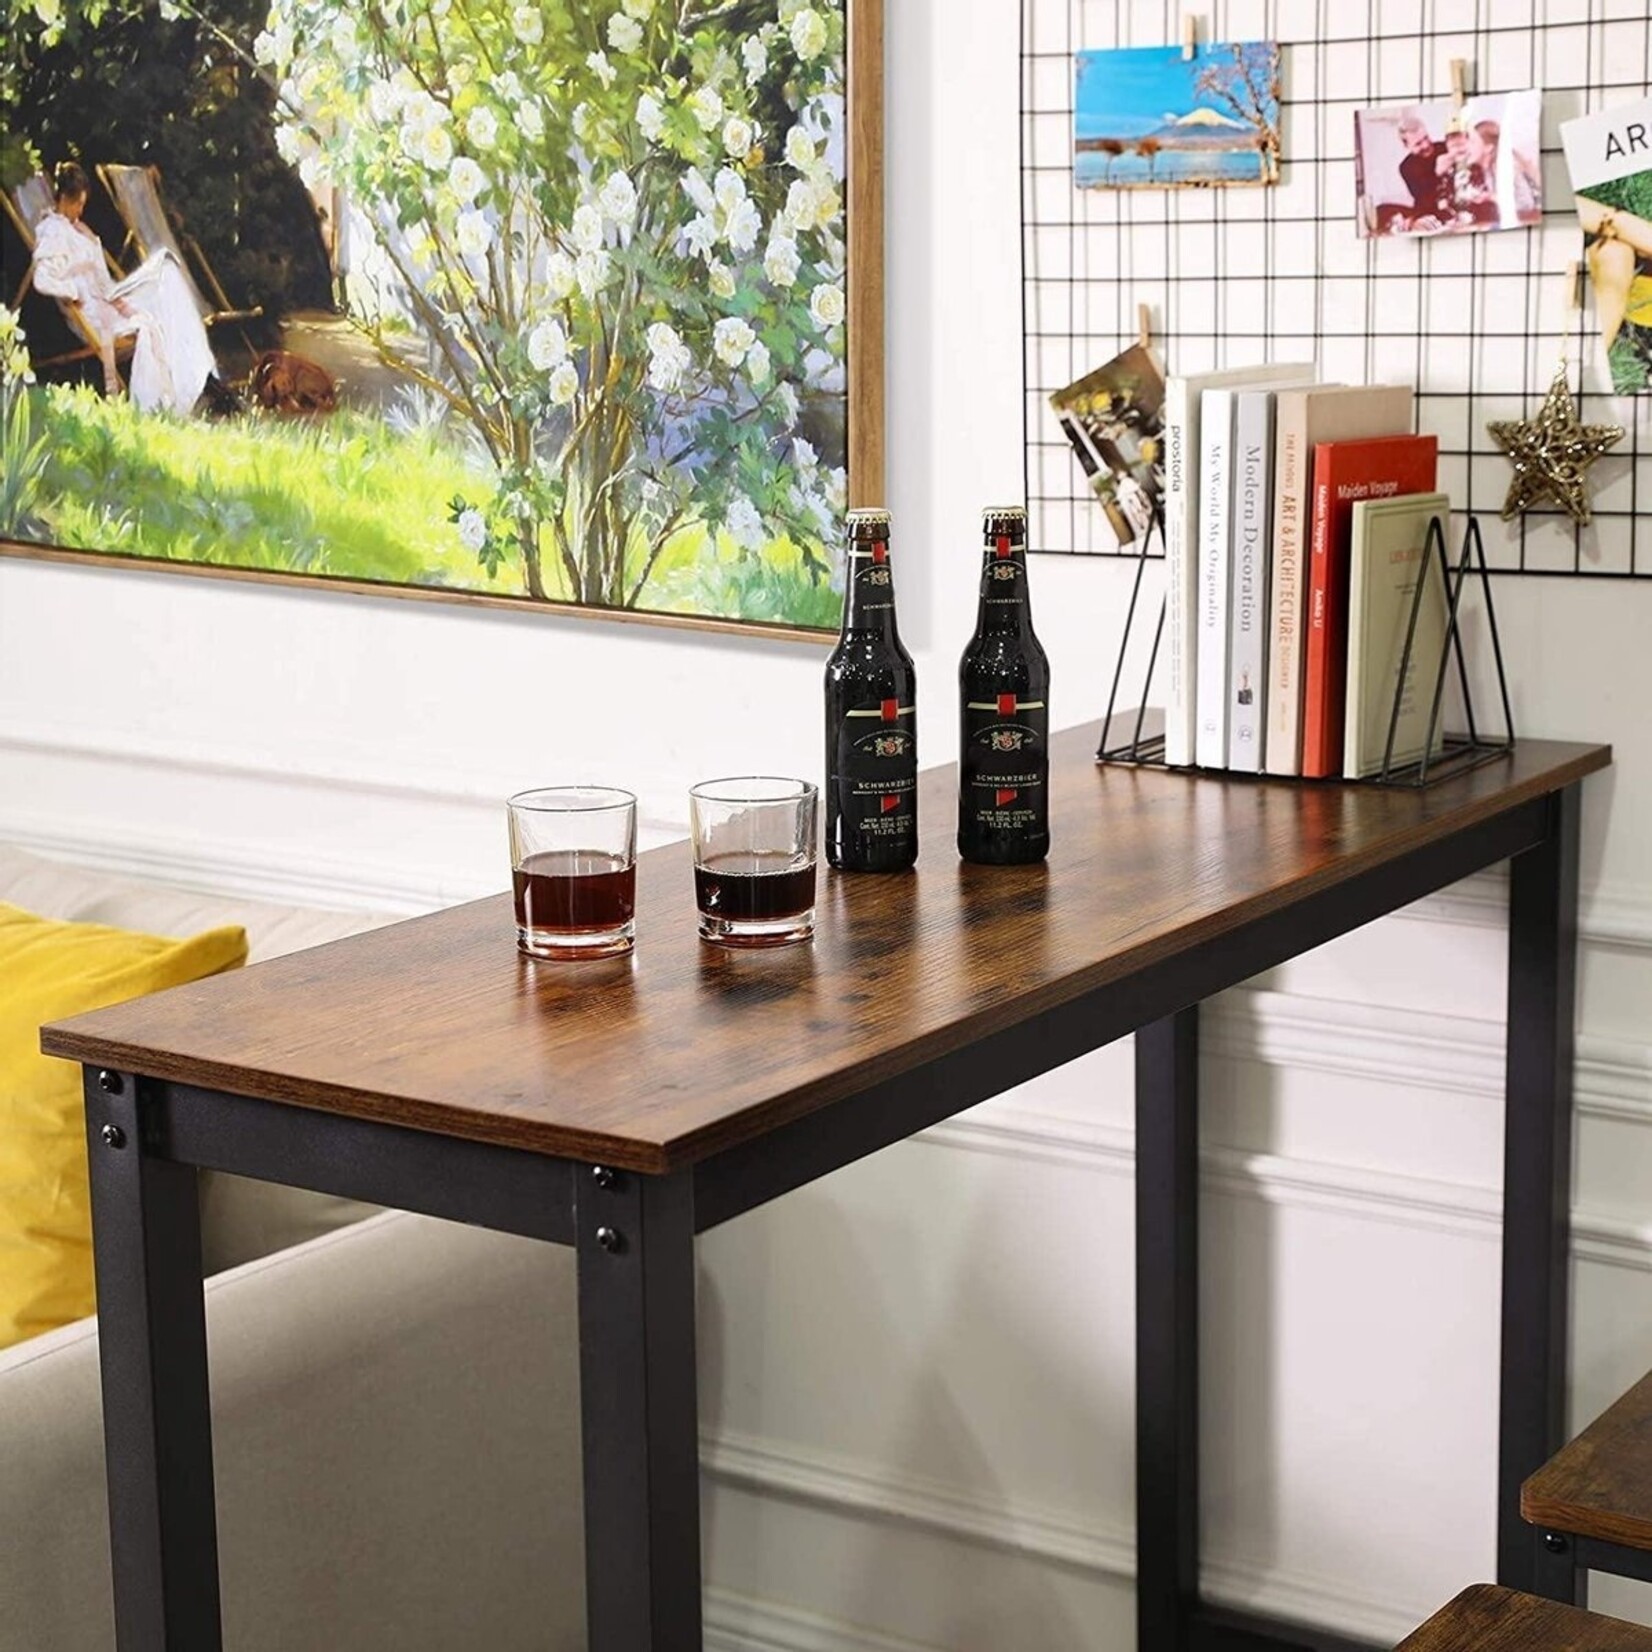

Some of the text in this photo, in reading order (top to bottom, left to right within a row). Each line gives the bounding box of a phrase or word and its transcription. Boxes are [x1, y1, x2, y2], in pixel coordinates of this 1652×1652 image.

[1604, 124, 1652, 161] AR
[1171, 425, 1184, 492] prostoria
[1338, 480, 1398, 499] Maiden Voyage
[1206, 444, 1222, 628] My World My Originality
[1241, 446, 1261, 632] Modern Decoration
[1282, 495, 1297, 520] ART
[1313, 484, 1328, 554] Maiden Voyage
[1279, 539, 1296, 642] ARCHITECTURE
[976, 773, 1037, 782] SCHWARZBIER
